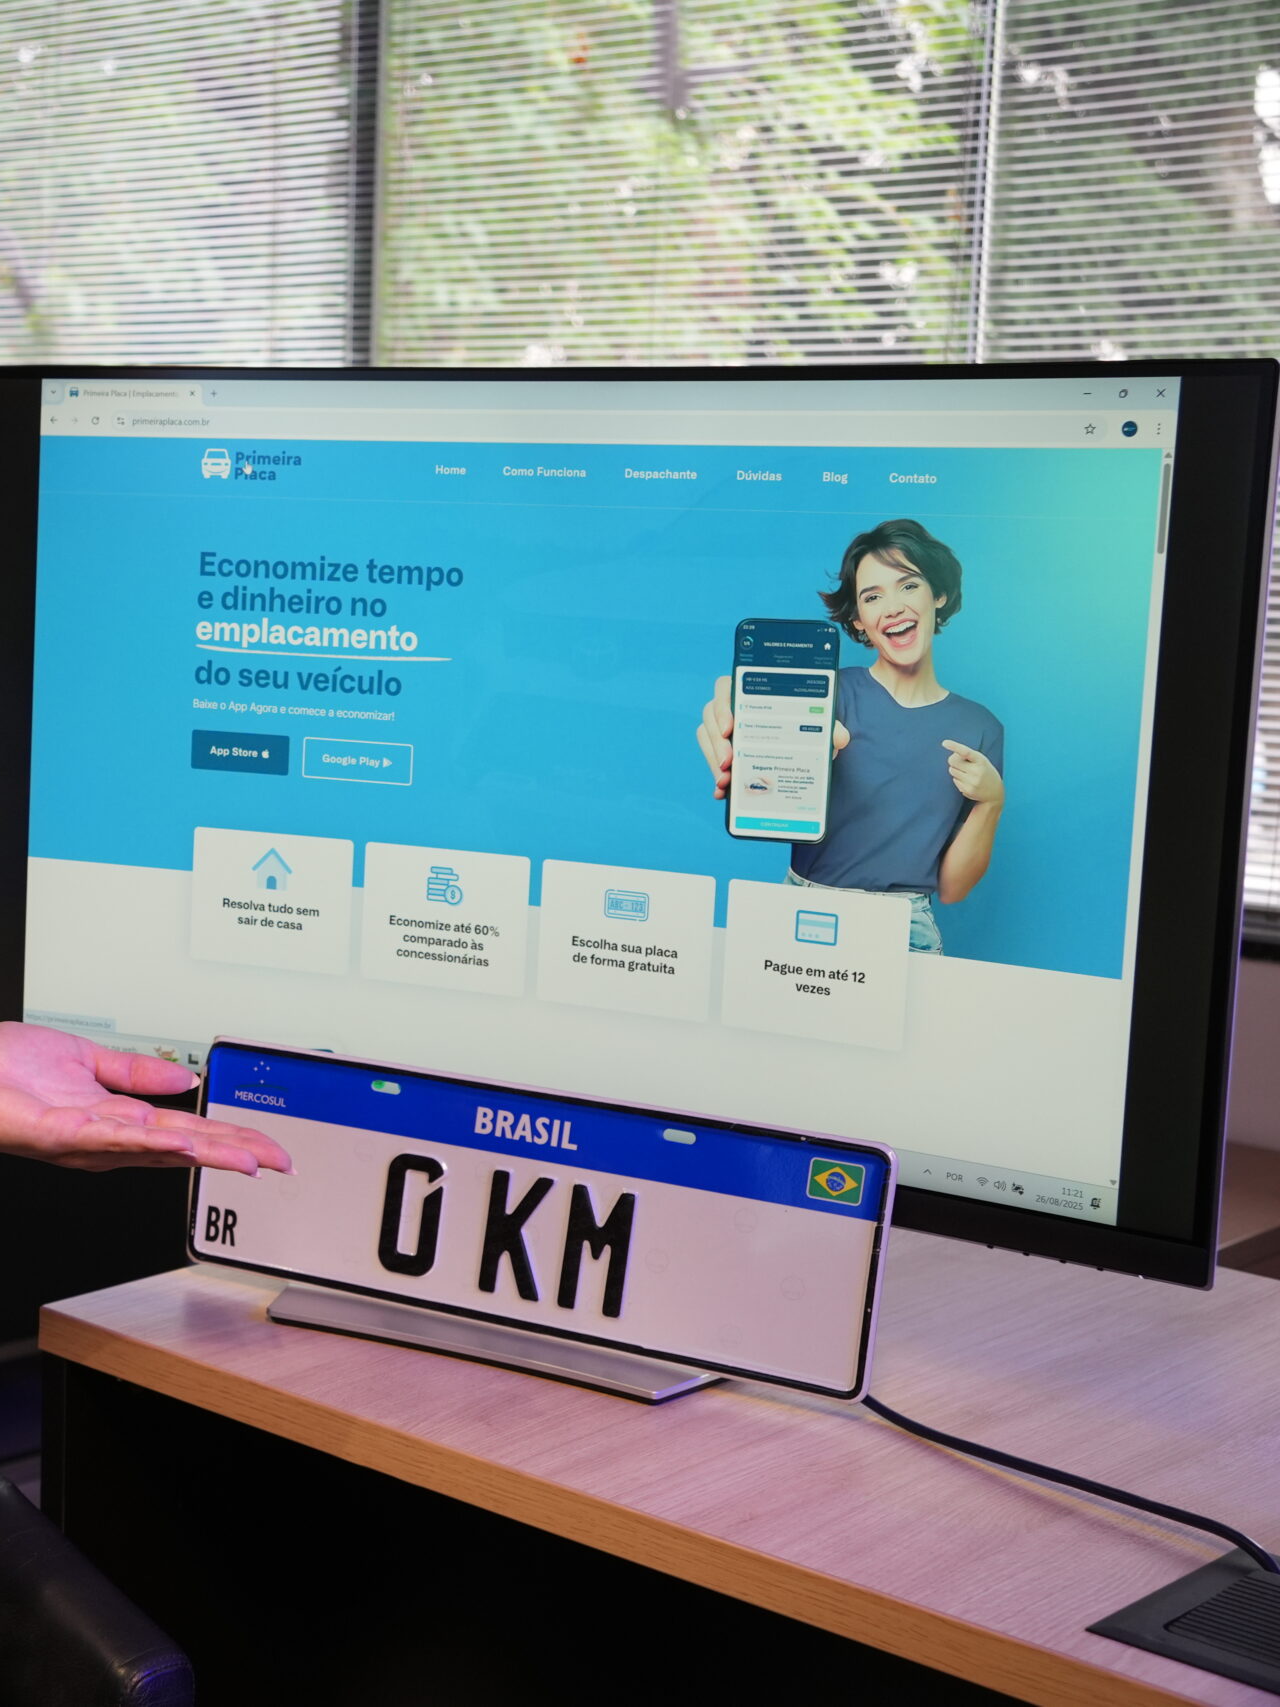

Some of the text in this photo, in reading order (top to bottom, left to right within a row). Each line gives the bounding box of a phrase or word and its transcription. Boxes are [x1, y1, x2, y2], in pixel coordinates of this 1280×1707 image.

[132, 418, 210, 427] primeiraplaca.com.br
[235, 450, 302, 466] Primeira
[435, 465, 466, 475] Home
[503, 466, 587, 478] Como Funciona
[624, 469, 697, 480] Despachante
[736, 470, 782, 481] Dúvidas
[822, 472, 848, 484] Blog
[889, 473, 937, 484] Contato
[199, 552, 464, 592] Economize tempo
[197, 585, 387, 618] e dinheiro no
[195, 617, 418, 651] emplacamento
[194, 660, 402, 696] do seu veículo
[192, 699, 395, 721] Baixe o App Agora e comece a economizar!
[210, 745, 258, 758] App Store
[322, 753, 381, 768] Google Play
[222, 898, 320, 917] Resolva tudo sem
[237, 914, 303, 931] sair de casa
[389, 915, 500, 938] Economize até 60%
[402, 932, 484, 951] comparado às
[571, 935, 678, 959] Escolha sua placa
[396, 947, 489, 967] concessionárias
[572, 952, 675, 975] de forma gratuita
[764, 960, 866, 984] Pague em até 12
[795, 982, 831, 996] vezes
[234, 1090, 287, 1108] MERCOSUL
[474, 1106, 578, 1151] BRASIL
[946, 1172, 964, 1184] POR
[1061, 1187, 1084, 1199] 11:21
[1036, 1194, 1084, 1212] 26/08/2025
[205, 1205, 237, 1247] BR
[478, 1169, 636, 1318] KM
